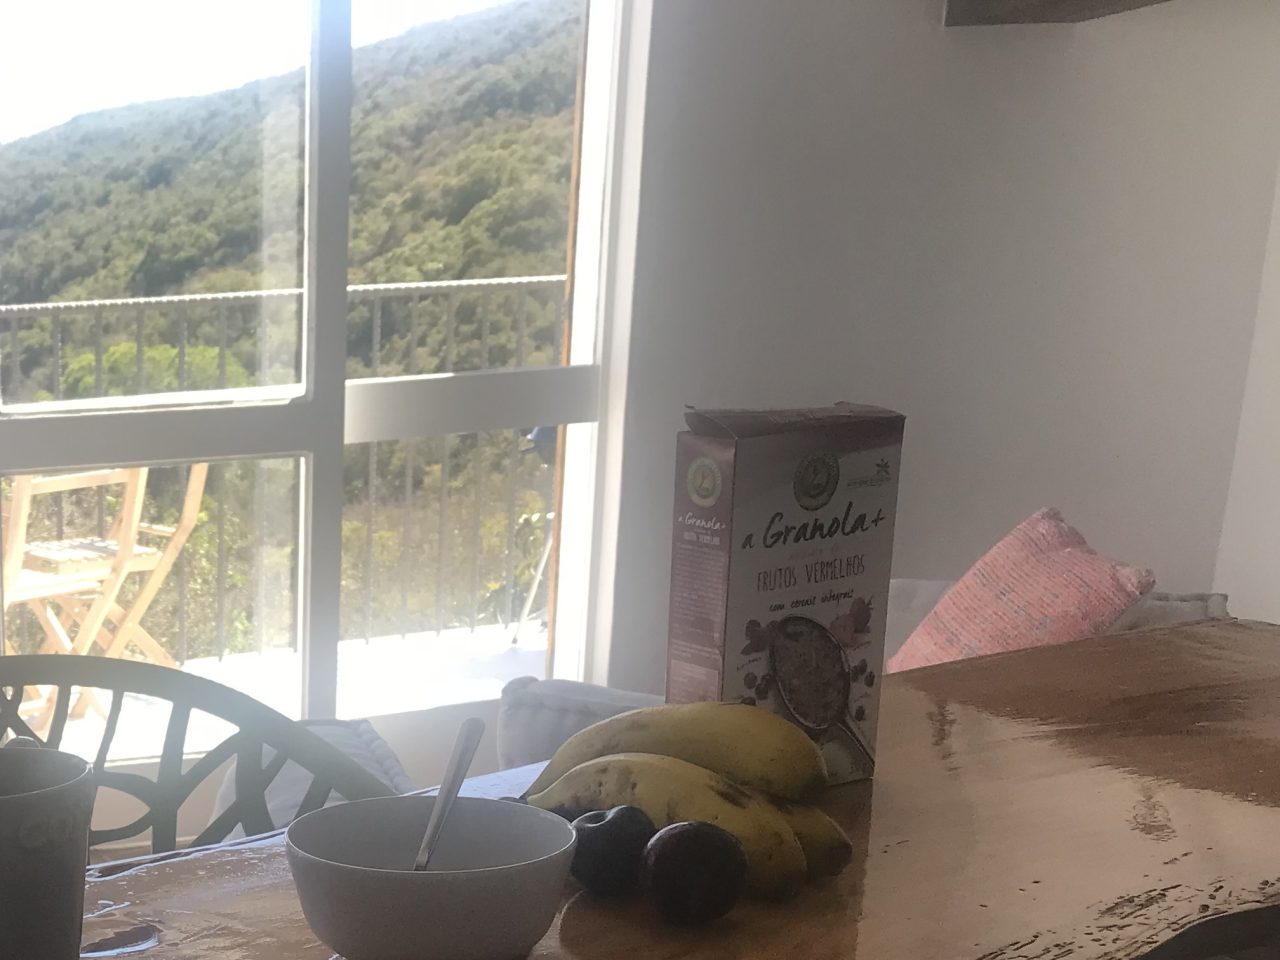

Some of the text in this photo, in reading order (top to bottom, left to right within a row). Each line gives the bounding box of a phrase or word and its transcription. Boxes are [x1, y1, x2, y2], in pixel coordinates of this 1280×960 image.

[741, 533, 756, 550] a
[757, 554, 865, 592] FRUTOS VERMELHOS
